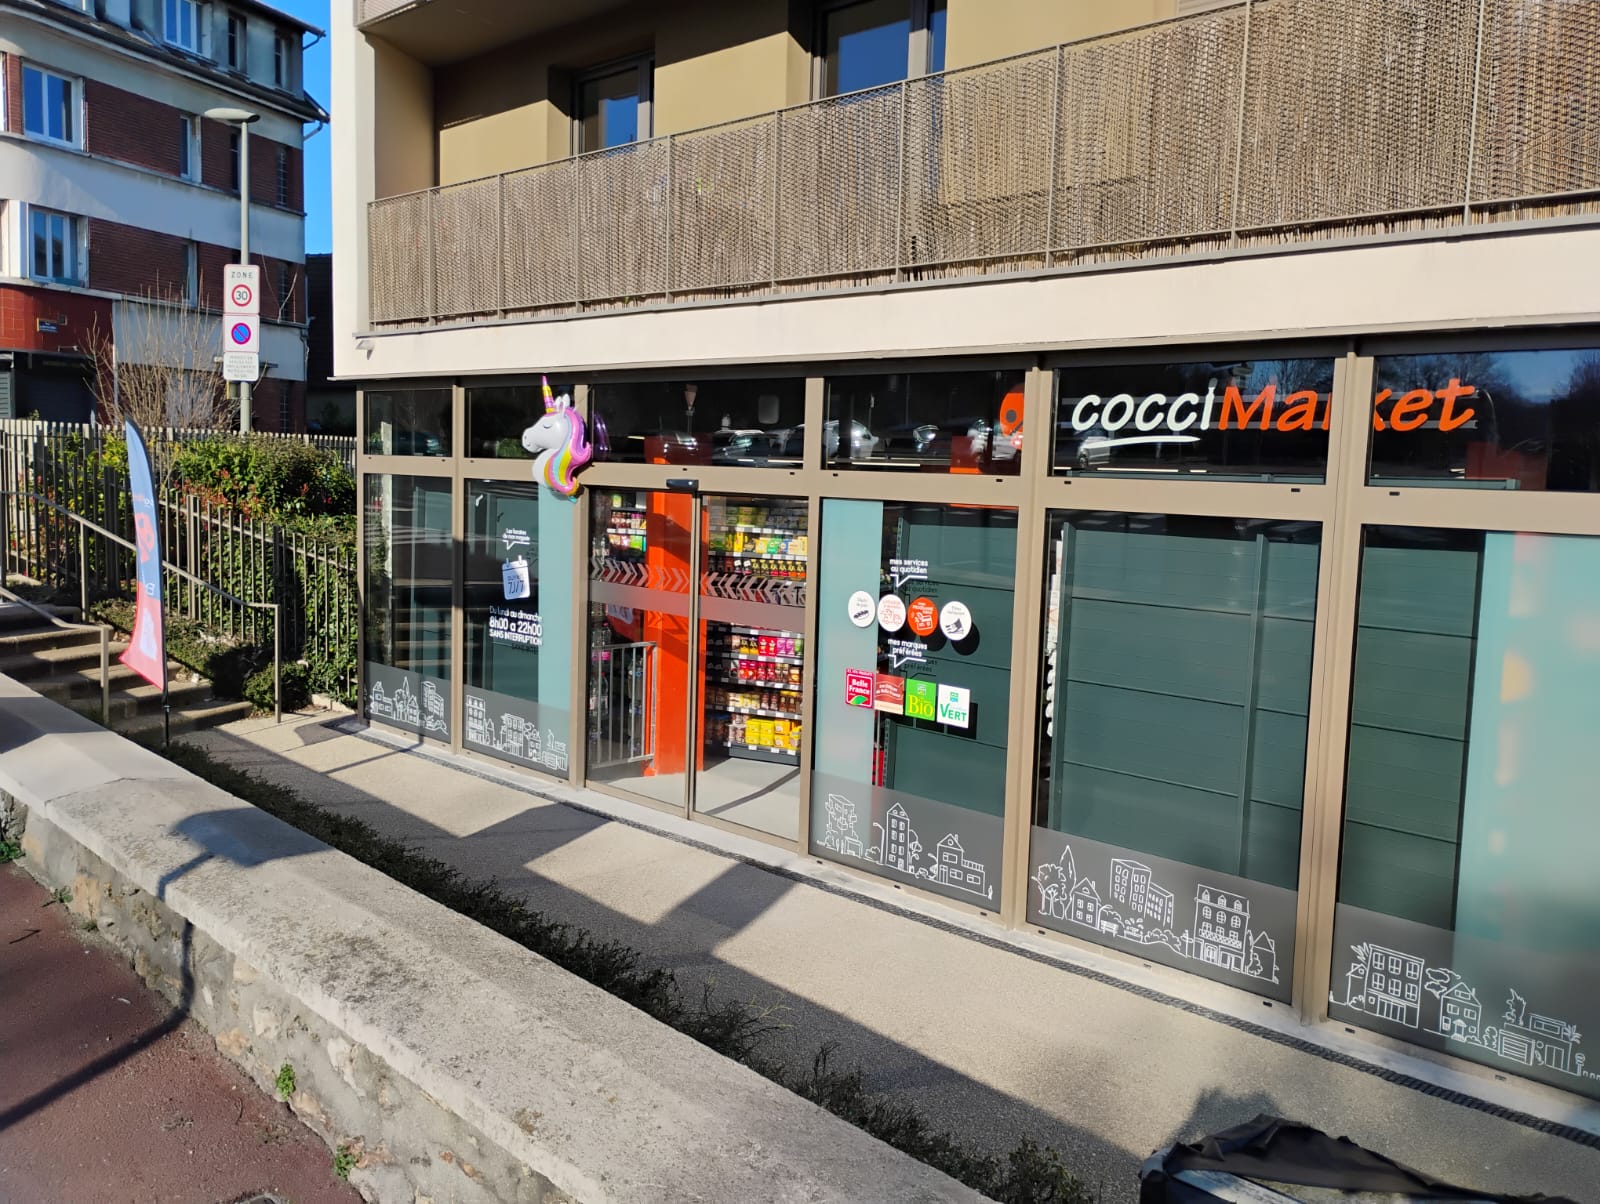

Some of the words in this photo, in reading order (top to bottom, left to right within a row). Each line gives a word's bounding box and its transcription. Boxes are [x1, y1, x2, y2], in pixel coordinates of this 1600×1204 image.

[231, 271, 254, 279] ZONE
[235, 290, 249, 301] 30
[903, 559, 928, 567] services
[900, 566, 928, 575] quotidien
[518, 609, 543, 622] dimanche
[489, 616, 509, 631] 8h00
[517, 620, 543, 637] 22h00
[489, 628, 505, 639] SANS
[505, 631, 543, 647] INTERRUPTION
[888, 638, 901, 646] mes
[901, 639, 928, 651] marques
[893, 647, 923, 658] préférées
[851, 678, 869, 688] Belle
[848, 685, 871, 695] France
[908, 694, 934, 718] Bio
[940, 703, 968, 722] VERT
